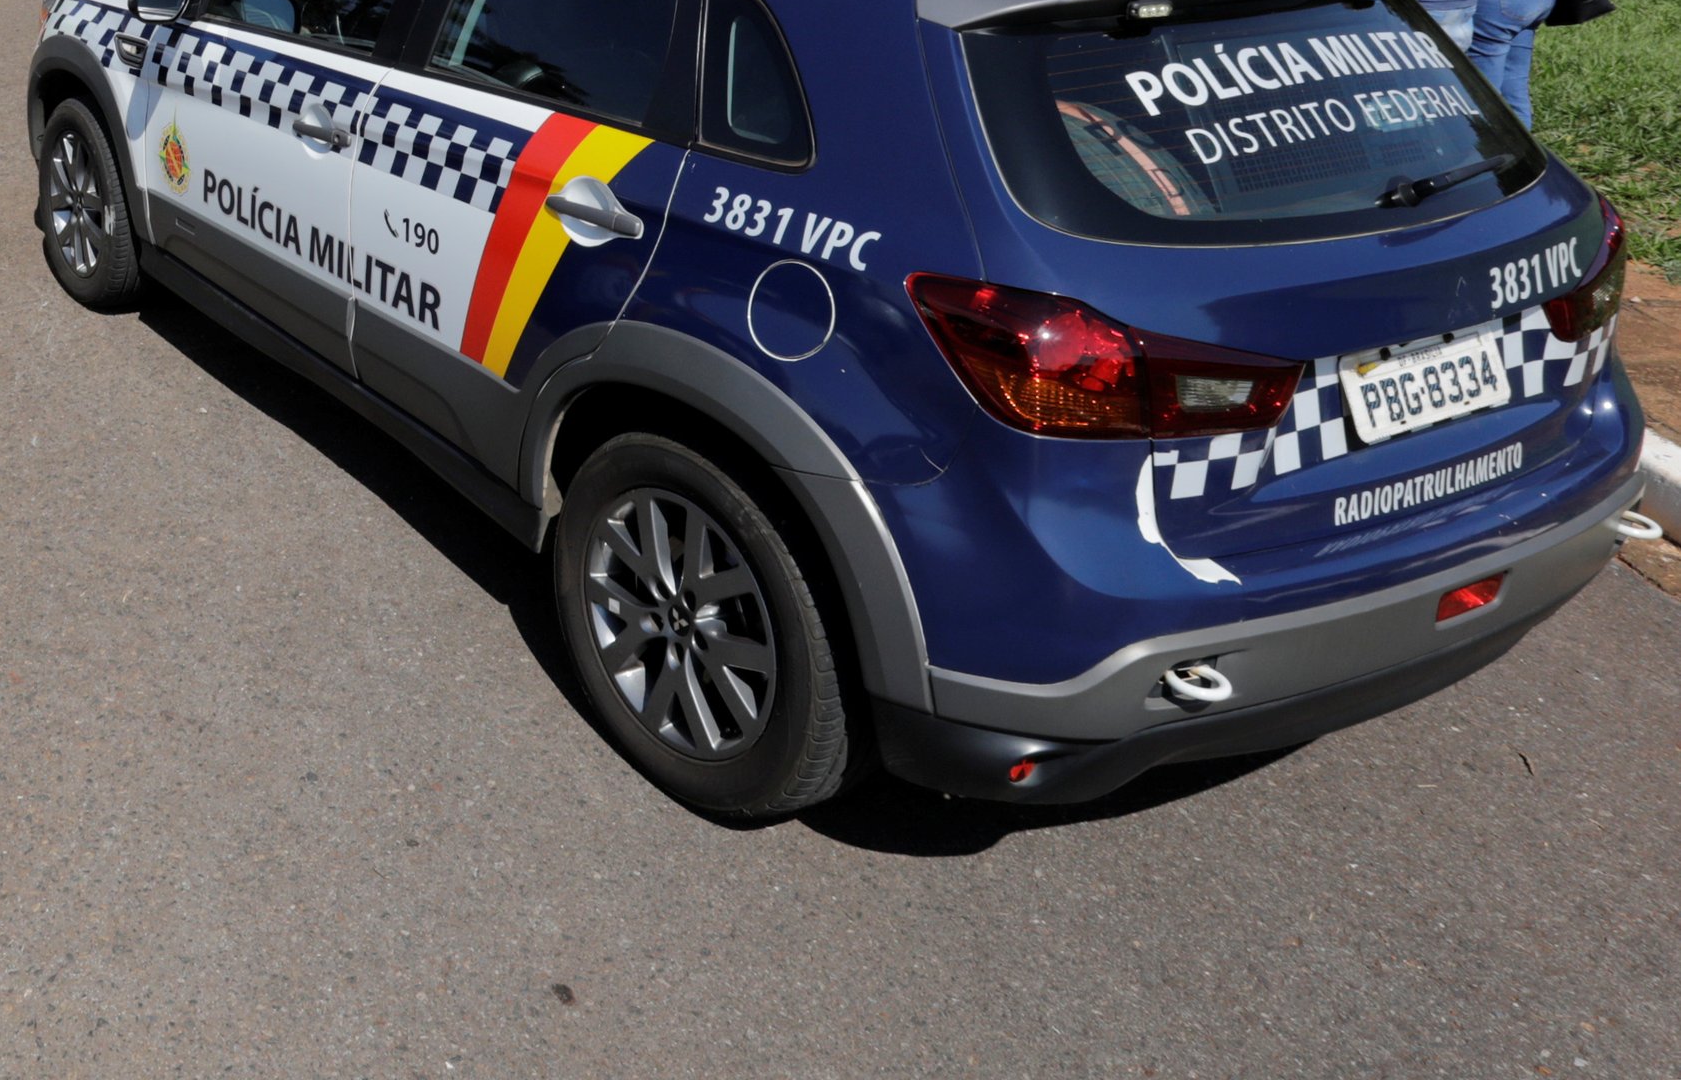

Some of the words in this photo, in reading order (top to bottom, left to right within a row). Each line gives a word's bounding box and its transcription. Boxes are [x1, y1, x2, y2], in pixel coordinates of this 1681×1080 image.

[1125, 43, 1324, 117] POLÍCIA
[1307, 30, 1454, 78] MILITAR
[1185, 97, 1356, 165] DISTRITO
[1353, 84, 1481, 128] FEDERAL
[203, 168, 302, 256] POLÍCIA
[309, 225, 441, 331] MILITAR
[402, 217, 439, 255] 190
[703, 186, 794, 245] 3831
[801, 212, 882, 271] VPC
[1489, 253, 1544, 310] 3831
[1545, 237, 1582, 288] VPC
[1333, 441, 1523, 526] RADIOPATRULHAMENTO
